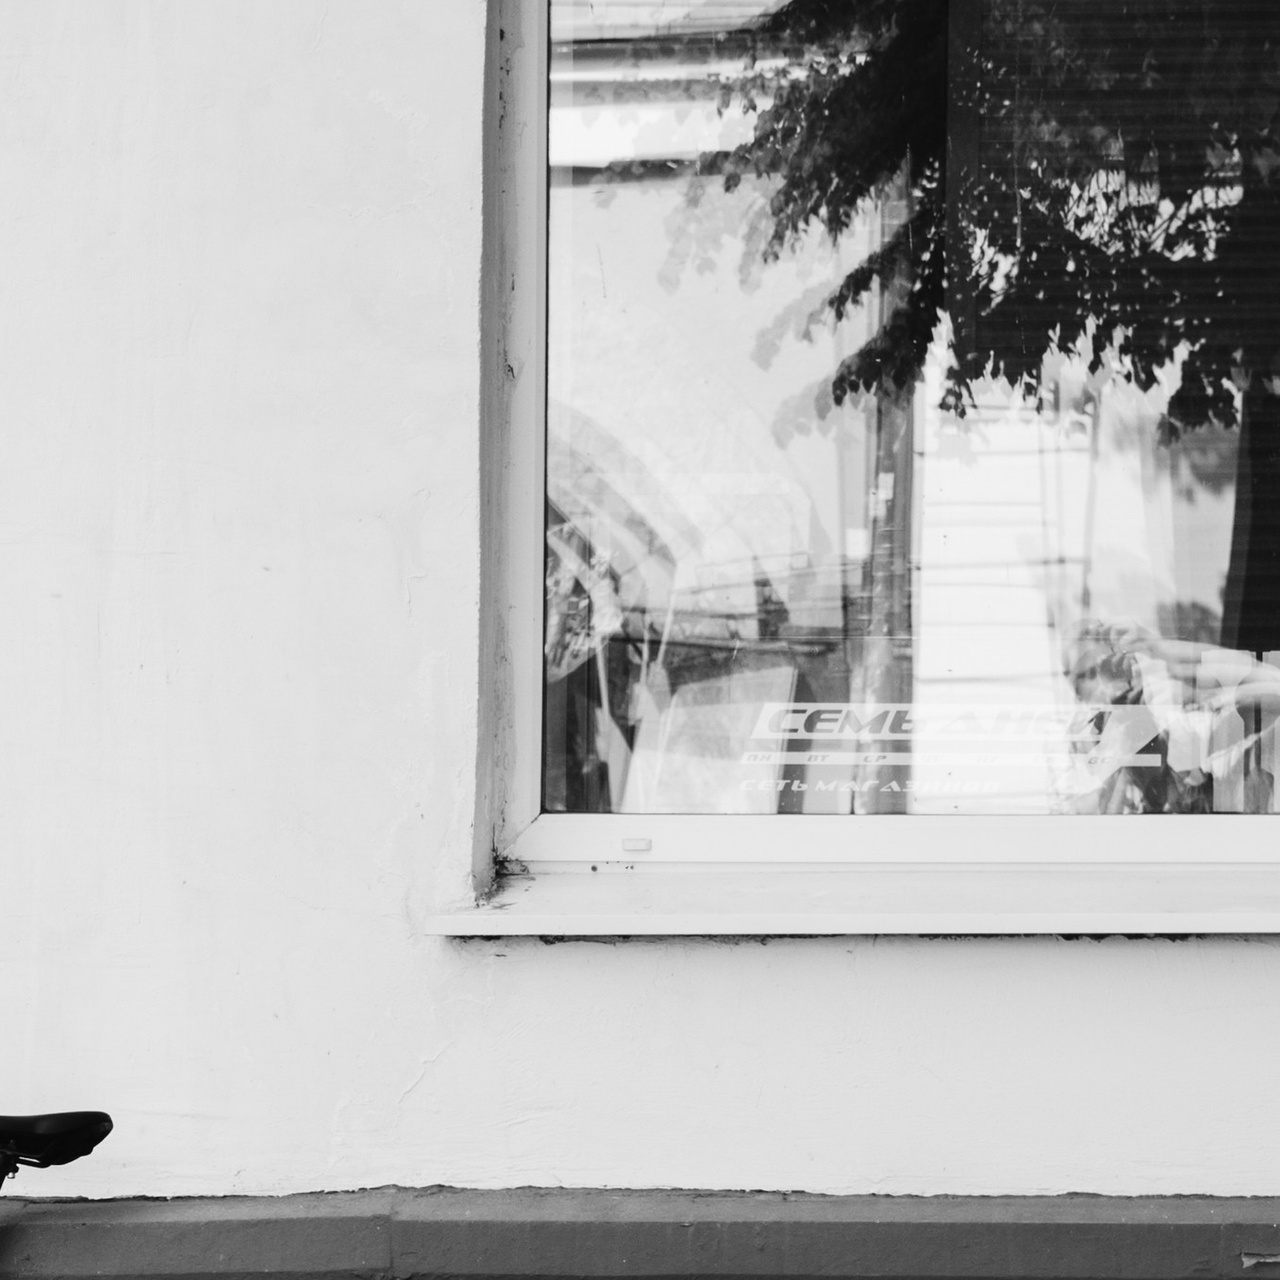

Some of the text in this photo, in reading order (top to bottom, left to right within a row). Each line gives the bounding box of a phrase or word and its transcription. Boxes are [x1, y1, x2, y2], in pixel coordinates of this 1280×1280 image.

[769, 709, 926, 734] СЕМЬ
[863, 755, 887, 763] СР
[739, 780, 808, 792] СЕТЬ
